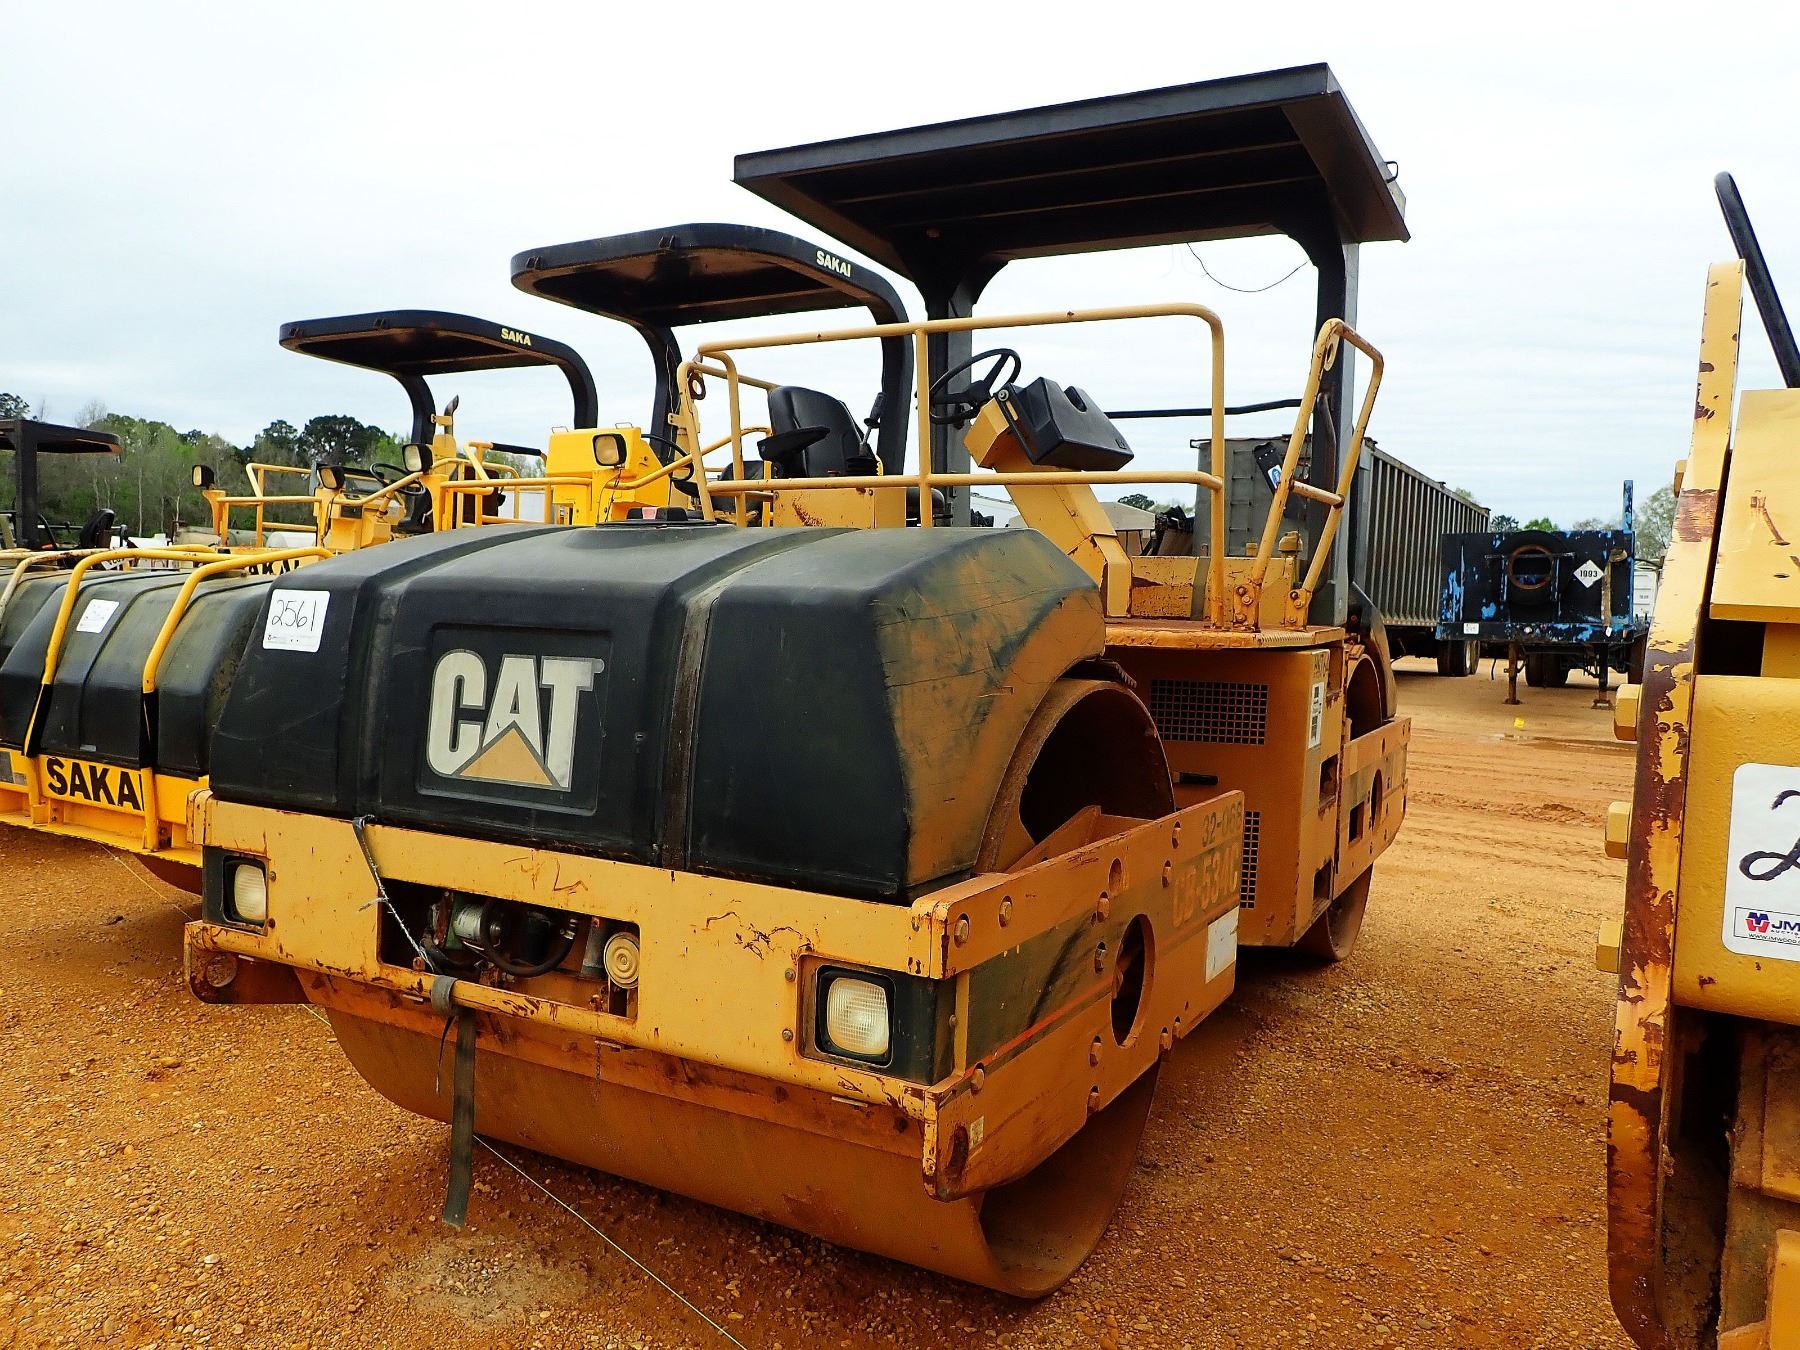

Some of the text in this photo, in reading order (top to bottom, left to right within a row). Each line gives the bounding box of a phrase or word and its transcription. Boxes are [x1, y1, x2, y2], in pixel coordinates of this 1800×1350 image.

[816, 250, 851, 278] SAKAI
[271, 599, 317, 632] 2561
[426, 649, 594, 793] CAT
